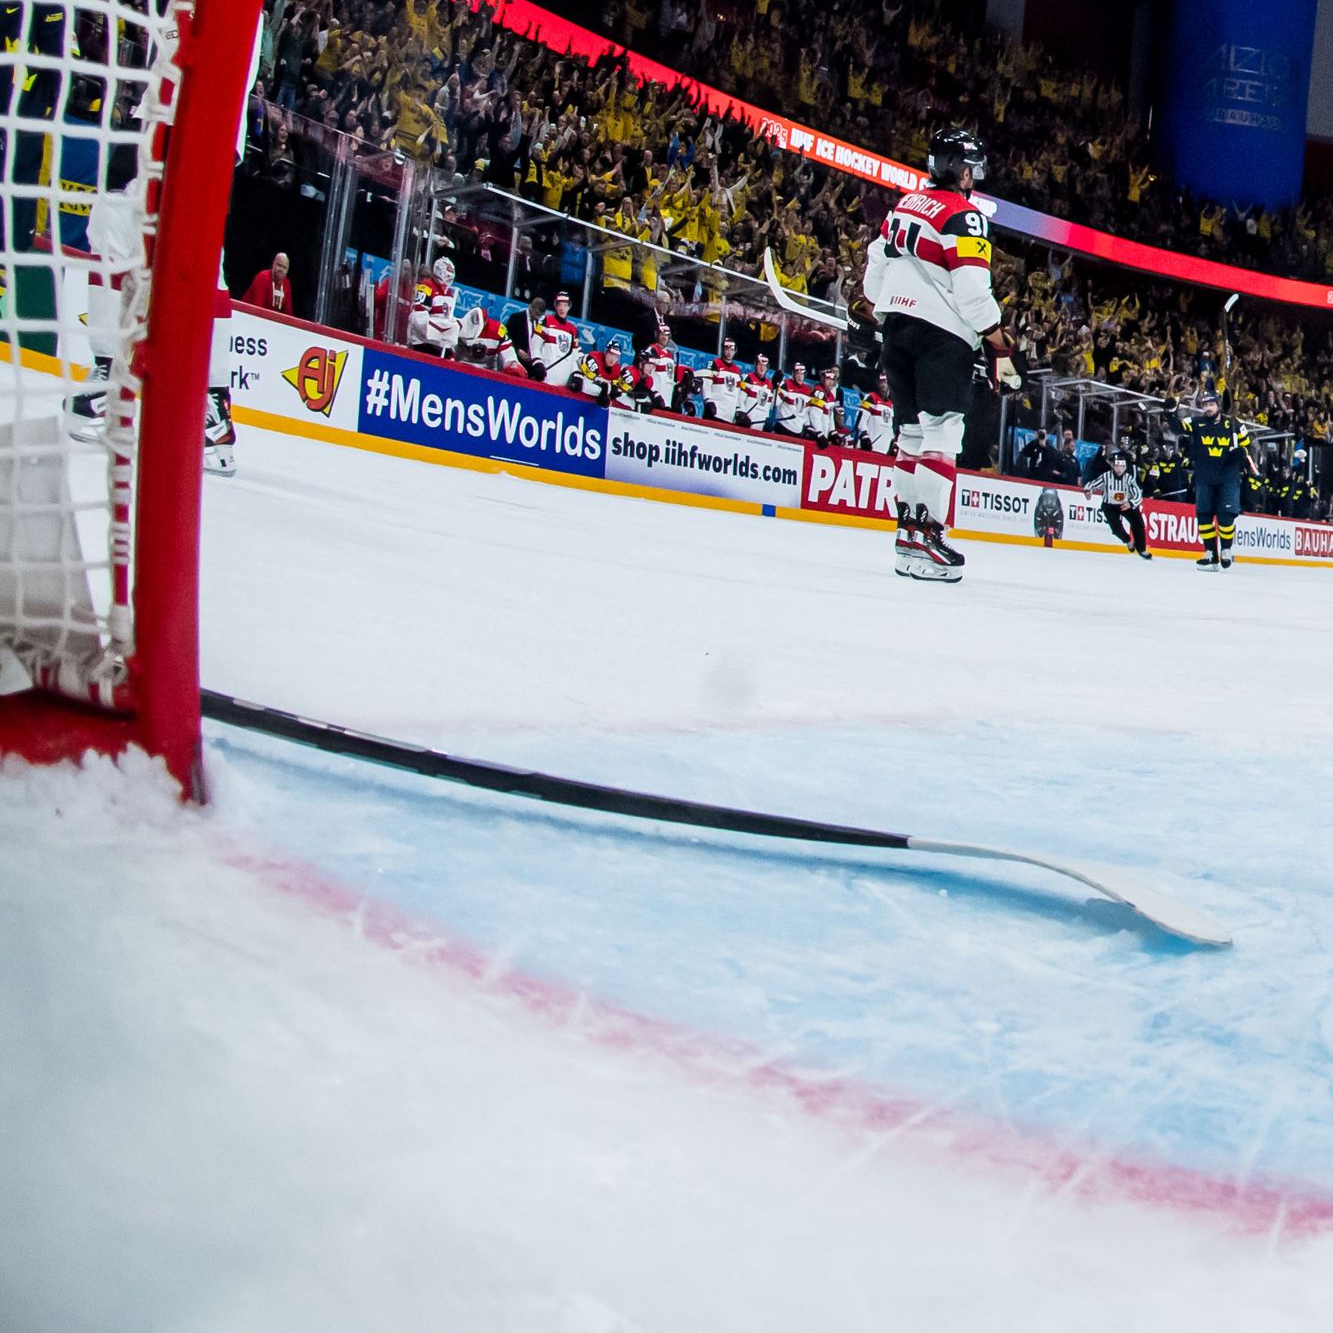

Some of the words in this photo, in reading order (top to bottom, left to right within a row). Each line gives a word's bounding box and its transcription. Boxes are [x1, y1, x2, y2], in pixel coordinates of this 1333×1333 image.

[816, 137, 835, 161] ICE
[835, 147, 881, 178] HOCKEY
[880, 163, 918, 192] WORLD
[965, 212, 989, 238] 91
[366, 368, 602, 460] #MensWorlds
[611, 431, 798, 486] shop.iihfworlds.com
[981, 492, 1030, 515] TISSOT
